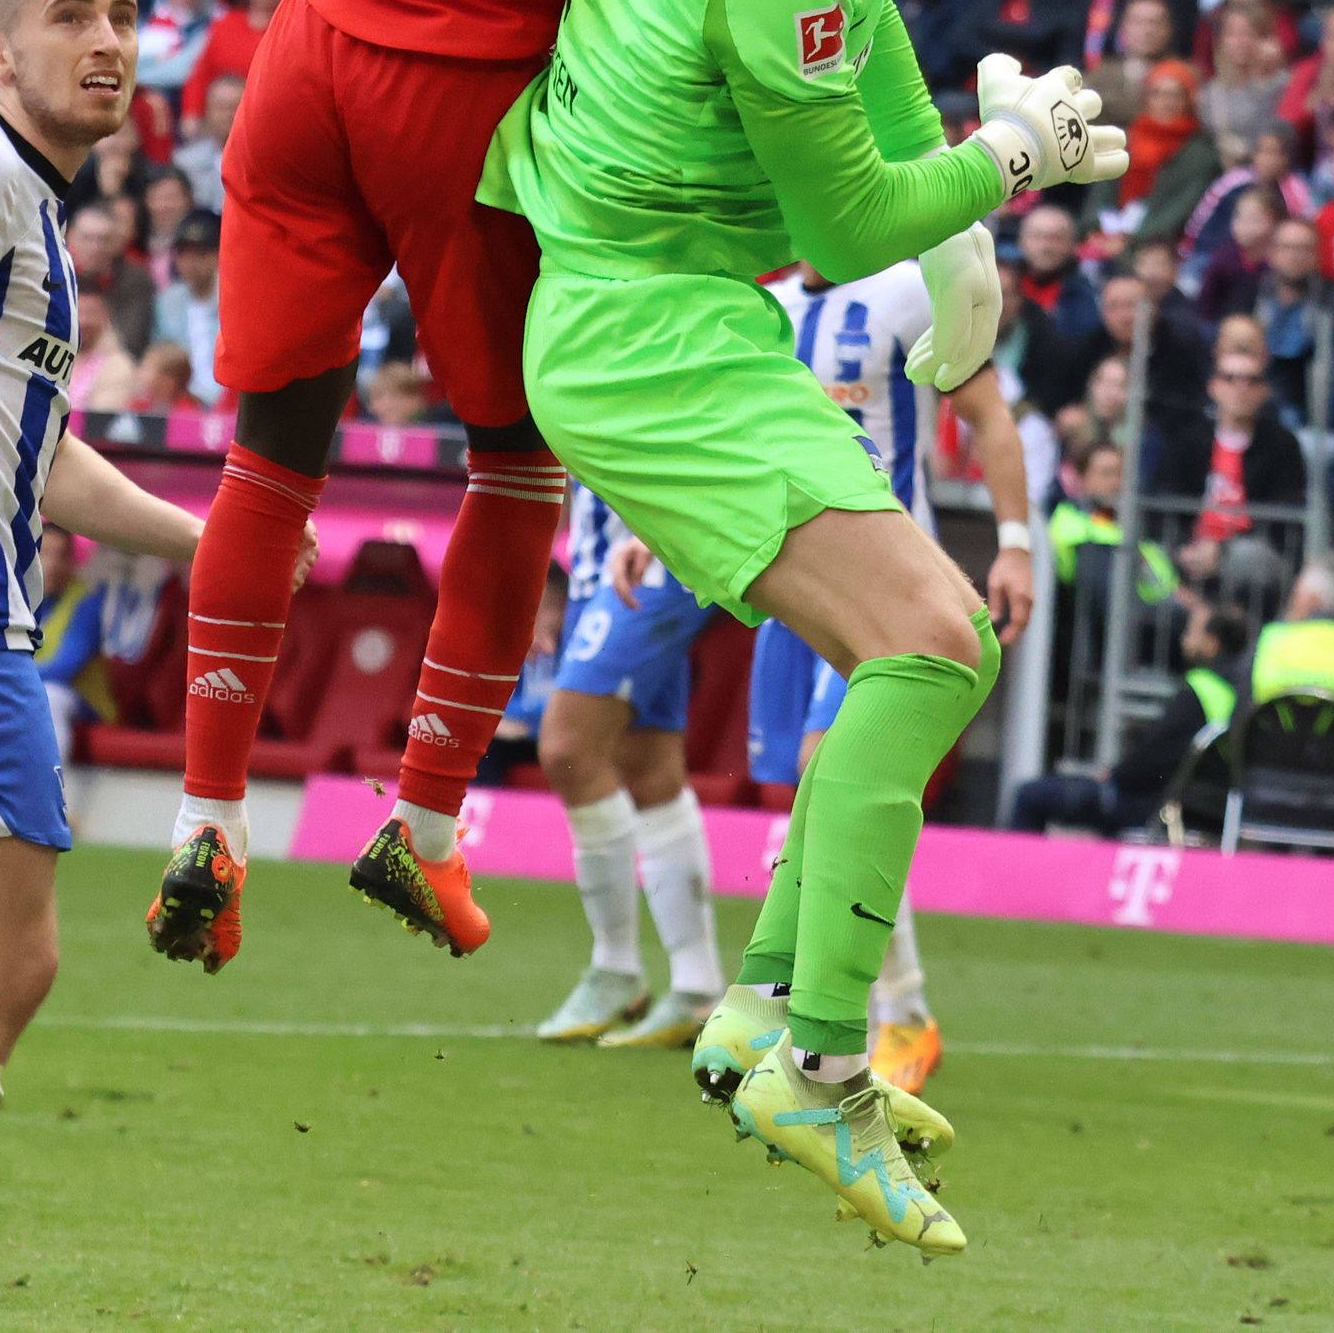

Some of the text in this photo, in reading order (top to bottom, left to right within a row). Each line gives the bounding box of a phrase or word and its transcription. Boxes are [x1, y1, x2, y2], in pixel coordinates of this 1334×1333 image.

[189, 682, 255, 704] adidas
[195, 841, 211, 868] FURON
[369, 833, 391, 859] FURON
